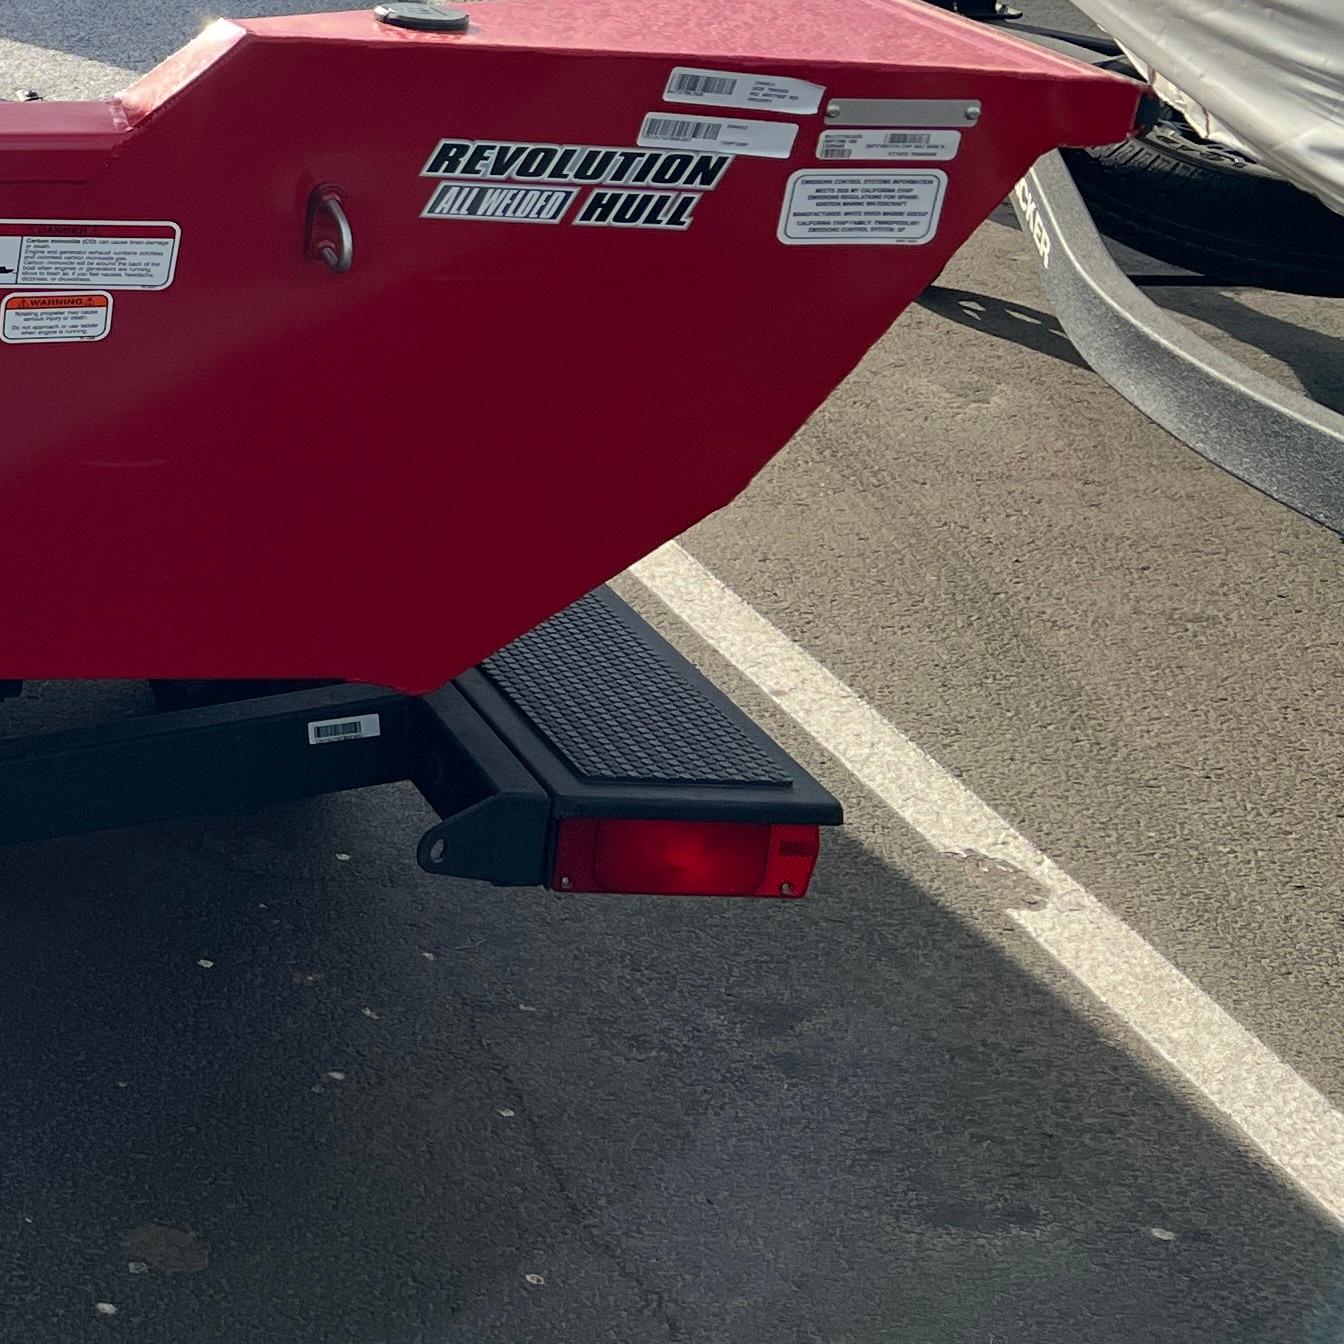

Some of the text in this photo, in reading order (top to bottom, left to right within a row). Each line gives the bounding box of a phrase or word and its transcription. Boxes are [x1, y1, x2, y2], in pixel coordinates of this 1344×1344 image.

[426, 142, 730, 187] REVOLUTION
[434, 186, 699, 226] ALL WELDED HULL
[30, 297, 83, 306] WARNING
